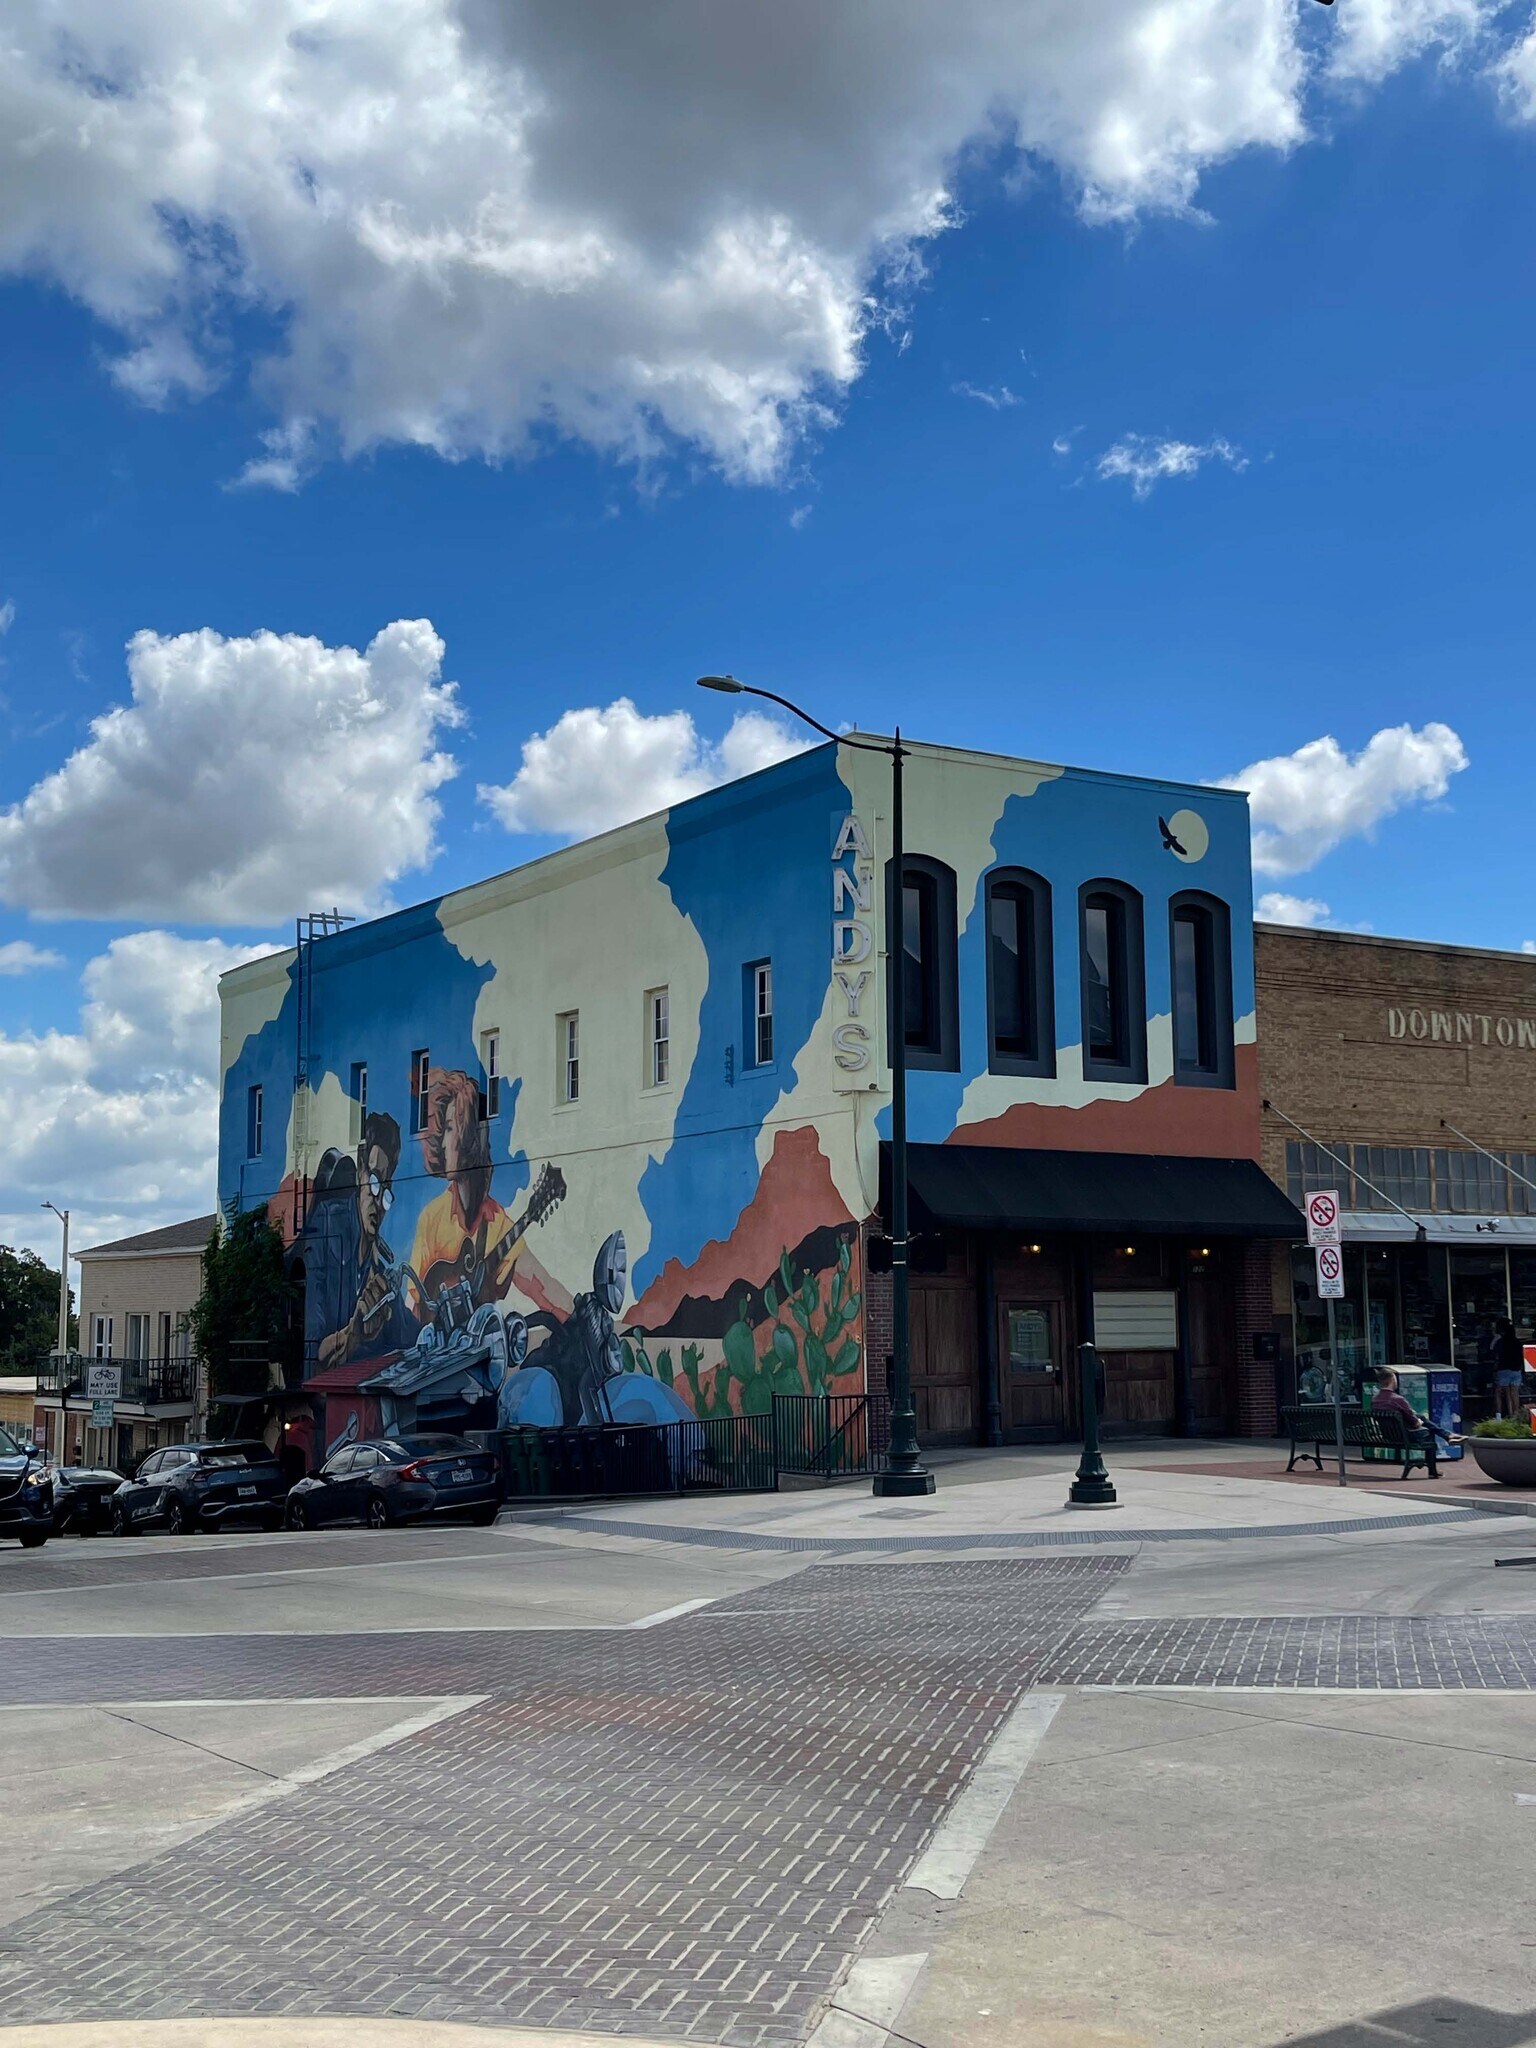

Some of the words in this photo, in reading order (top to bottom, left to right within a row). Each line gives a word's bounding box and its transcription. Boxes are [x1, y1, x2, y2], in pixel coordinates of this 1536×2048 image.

[830, 814, 873, 1072] ANDYS
[1388, 1007, 1536, 1049] DOWNTOW
[94, 1401, 100, 1409] 2
